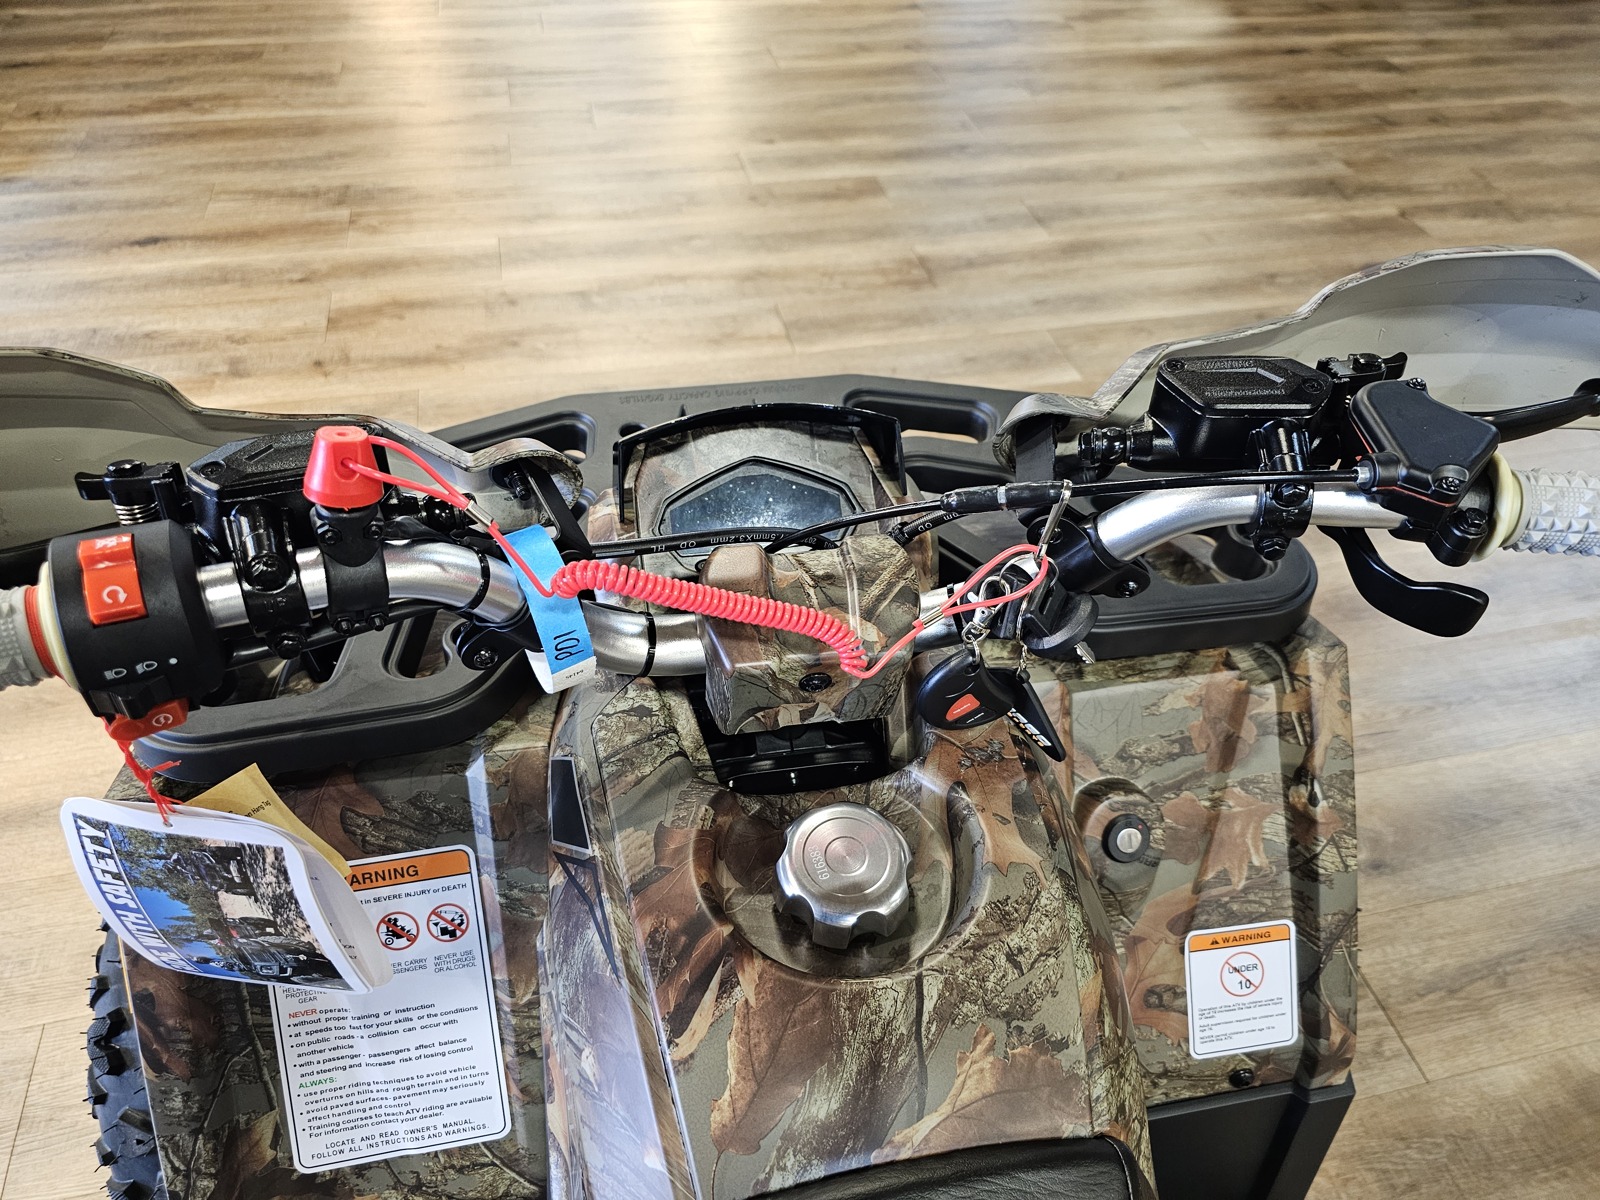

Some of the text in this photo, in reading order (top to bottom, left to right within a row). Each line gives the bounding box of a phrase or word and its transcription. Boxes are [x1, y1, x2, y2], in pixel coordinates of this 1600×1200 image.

[77, 818, 139, 909] SAFETY
[345, 864, 420, 886] ARNING
[372, 892, 403, 903] SEVERE
[404, 888, 431, 898] INJURY
[441, 882, 467, 892] DEATH
[115, 909, 168, 949] WITH
[1221, 931, 1272, 944] WARNING
[404, 957, 428, 967] CARRY
[433, 949, 473, 961] NEVER USE
[433, 954, 476, 967] WITH DRUGS
[392, 963, 428, 975] SSENGERS
[433, 961, 477, 974] OR ALCOHOL
[1228, 963, 1259, 974] UNDER
[1238, 979, 1252, 990] 10
[297, 995, 318, 1004] GEAR
[288, 1008, 317, 1019] NEVER
[292, 1017, 322, 1028] without
[351, 1012, 380, 1021] training
[394, 1003, 435, 1014] instruction
[304, 1026, 333, 1036] speeds
[377, 1020, 393, 1028] your
[393, 1016, 413, 1024] skills
[439, 1005, 478, 1017] conditions
[306, 1036, 331, 1047] public
[367, 1029, 399, 1039] collision
[419, 1022, 441, 1030] occur
[442, 1018, 458, 1026] with
[296, 1043, 354, 1058] another vehicle
[298, 1060, 315, 1068] with
[322, 1053, 361, 1065] passenger
[368, 1047, 411, 1059] passengers
[414, 1042, 435, 1051] affect
[438, 1037, 467, 1046] balance
[299, 1070, 315, 1078] and
[315, 1065, 347, 1075] steering
[414, 1053, 422, 1061] of
[423, 1051, 446, 1059] losing
[447, 1045, 474, 1055] control
[298, 1076, 337, 1089] ALWAYS:
[304, 1094, 344, 1106] overturns
[357, 1088, 374, 1096] hills
[392, 1083, 416, 1092] rough
[416, 1079, 443, 1088] terrain
[444, 1075, 459, 1083] and
[319, 1085, 346, 1095] proper
[348, 1081, 371, 1089] riding
[372, 1076, 415, 1085] techniques
[425, 1069, 447, 1078] avoid
[448, 1064, 476, 1074] vehicle
[306, 1105, 328, 1114] avoid
[329, 1100, 354, 1111] paved
[392, 1089, 430, 1101] pavement
[449, 1080, 485, 1090] seriously
[307, 1113, 330, 1123] affect
[331, 1107, 367, 1118] handling
[383, 1100, 411, 1109] control
[307, 1121, 341, 1131] Training
[341, 1115, 373, 1125] courses
[405, 1107, 421, 1115] ATV
[422, 1104, 445, 1112] riding
[459, 1095, 493, 1106] available
[308, 1111, 444, 1139] For information contact your dealer.
[311, 1123, 489, 1160] FOLLOW ALL INSTRUCTIONS AND WARNINGS.
[325, 1137, 356, 1150] LOCATE
[360, 1134, 376, 1142] AND
[378, 1130, 399, 1139] READ
[403, 1124, 438, 1135] OWNER'S
